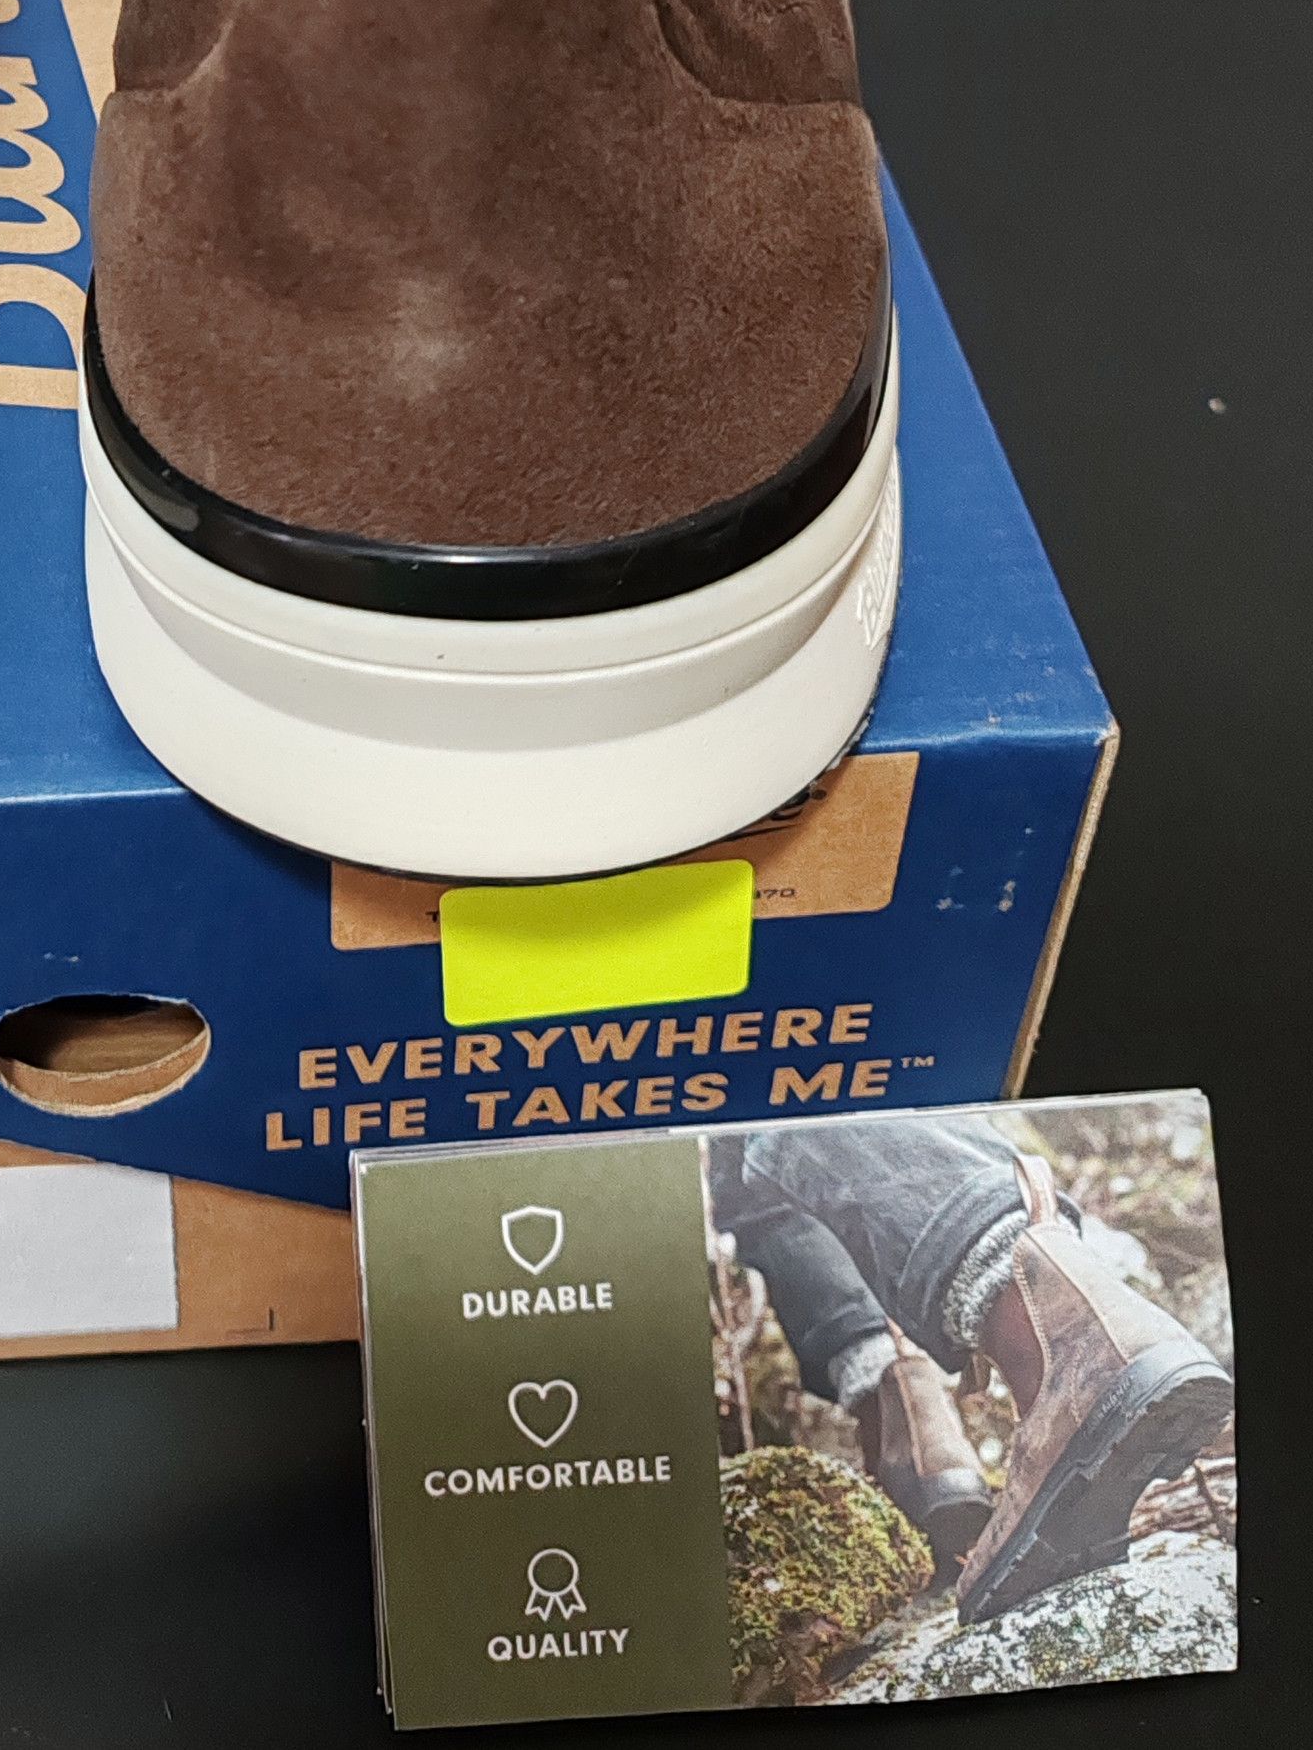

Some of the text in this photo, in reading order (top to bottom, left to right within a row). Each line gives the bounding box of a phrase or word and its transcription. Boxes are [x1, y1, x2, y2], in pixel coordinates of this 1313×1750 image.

[297, 1002, 874, 1090] EVERYWHERE
[265, 1098, 426, 1152] LIFE
[467, 1073, 727, 1130] TAKES
[461, 1281, 614, 1321] DURABLE
[423, 1455, 672, 1499] COMFORTABLE
[486, 1627, 630, 1663] QUALITY
